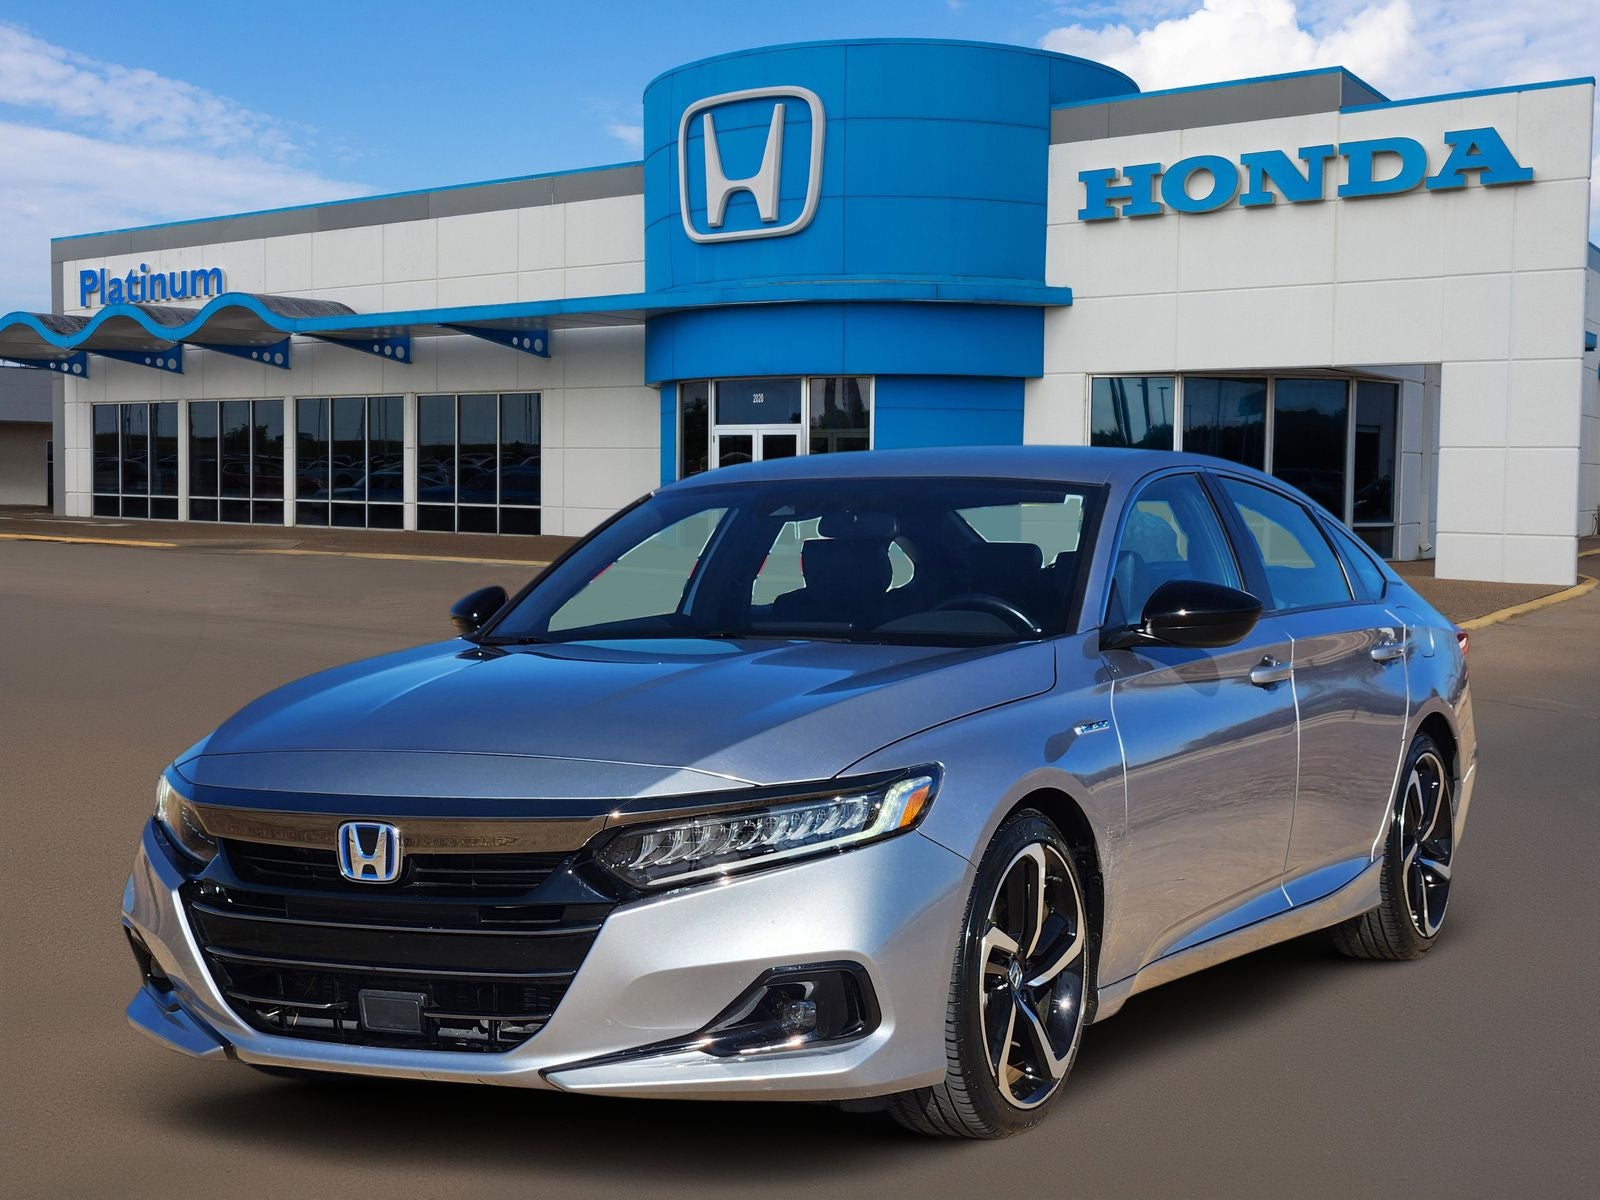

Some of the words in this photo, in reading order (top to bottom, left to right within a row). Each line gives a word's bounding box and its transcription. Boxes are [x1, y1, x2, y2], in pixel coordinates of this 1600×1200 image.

[703, 103, 785, 228] H
[1078, 127, 1534, 221] HONDA
[80, 263, 223, 307] Platinum
